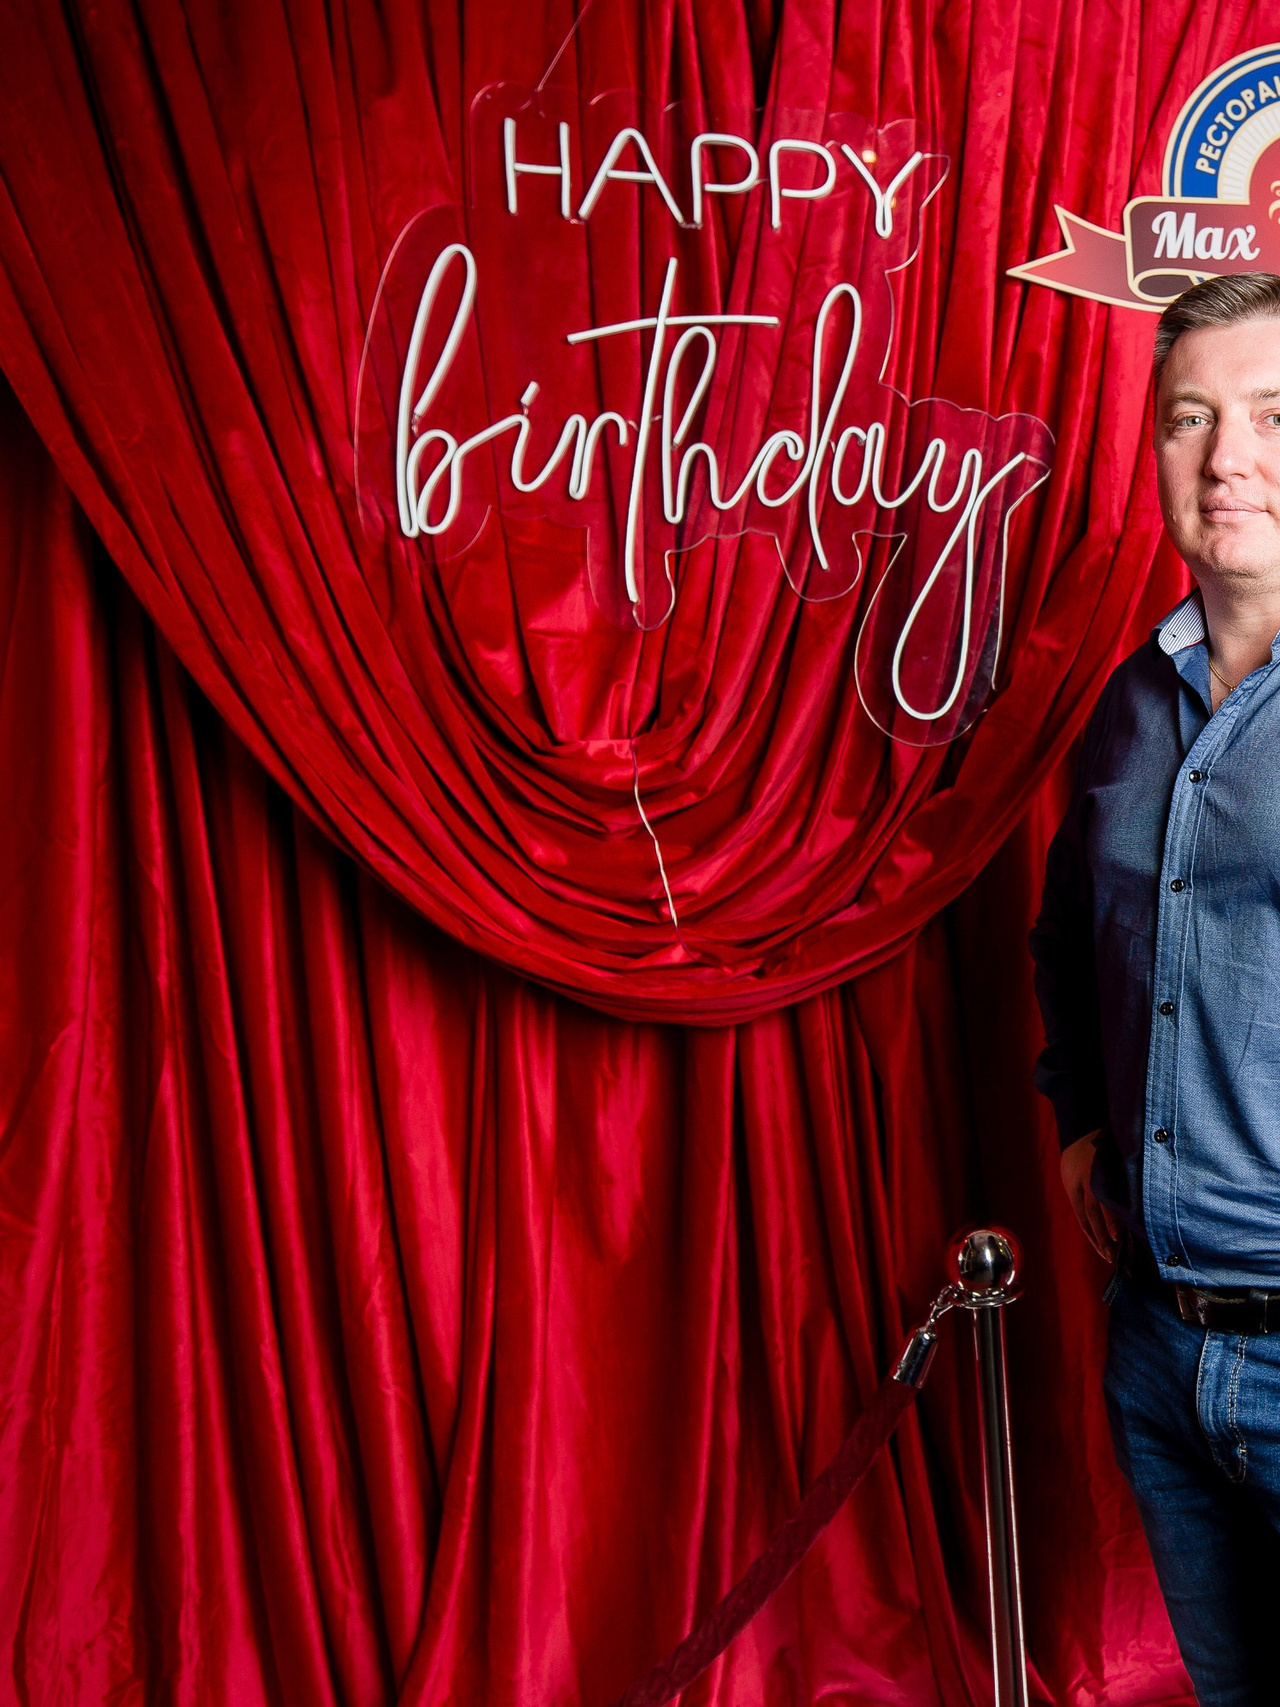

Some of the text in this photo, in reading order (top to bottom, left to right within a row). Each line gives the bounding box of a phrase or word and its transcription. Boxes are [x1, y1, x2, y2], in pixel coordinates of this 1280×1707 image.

[504, 117, 924, 238] HAPPY
[1151, 210, 1261, 262] Max
[397, 244, 1025, 721] birthday
